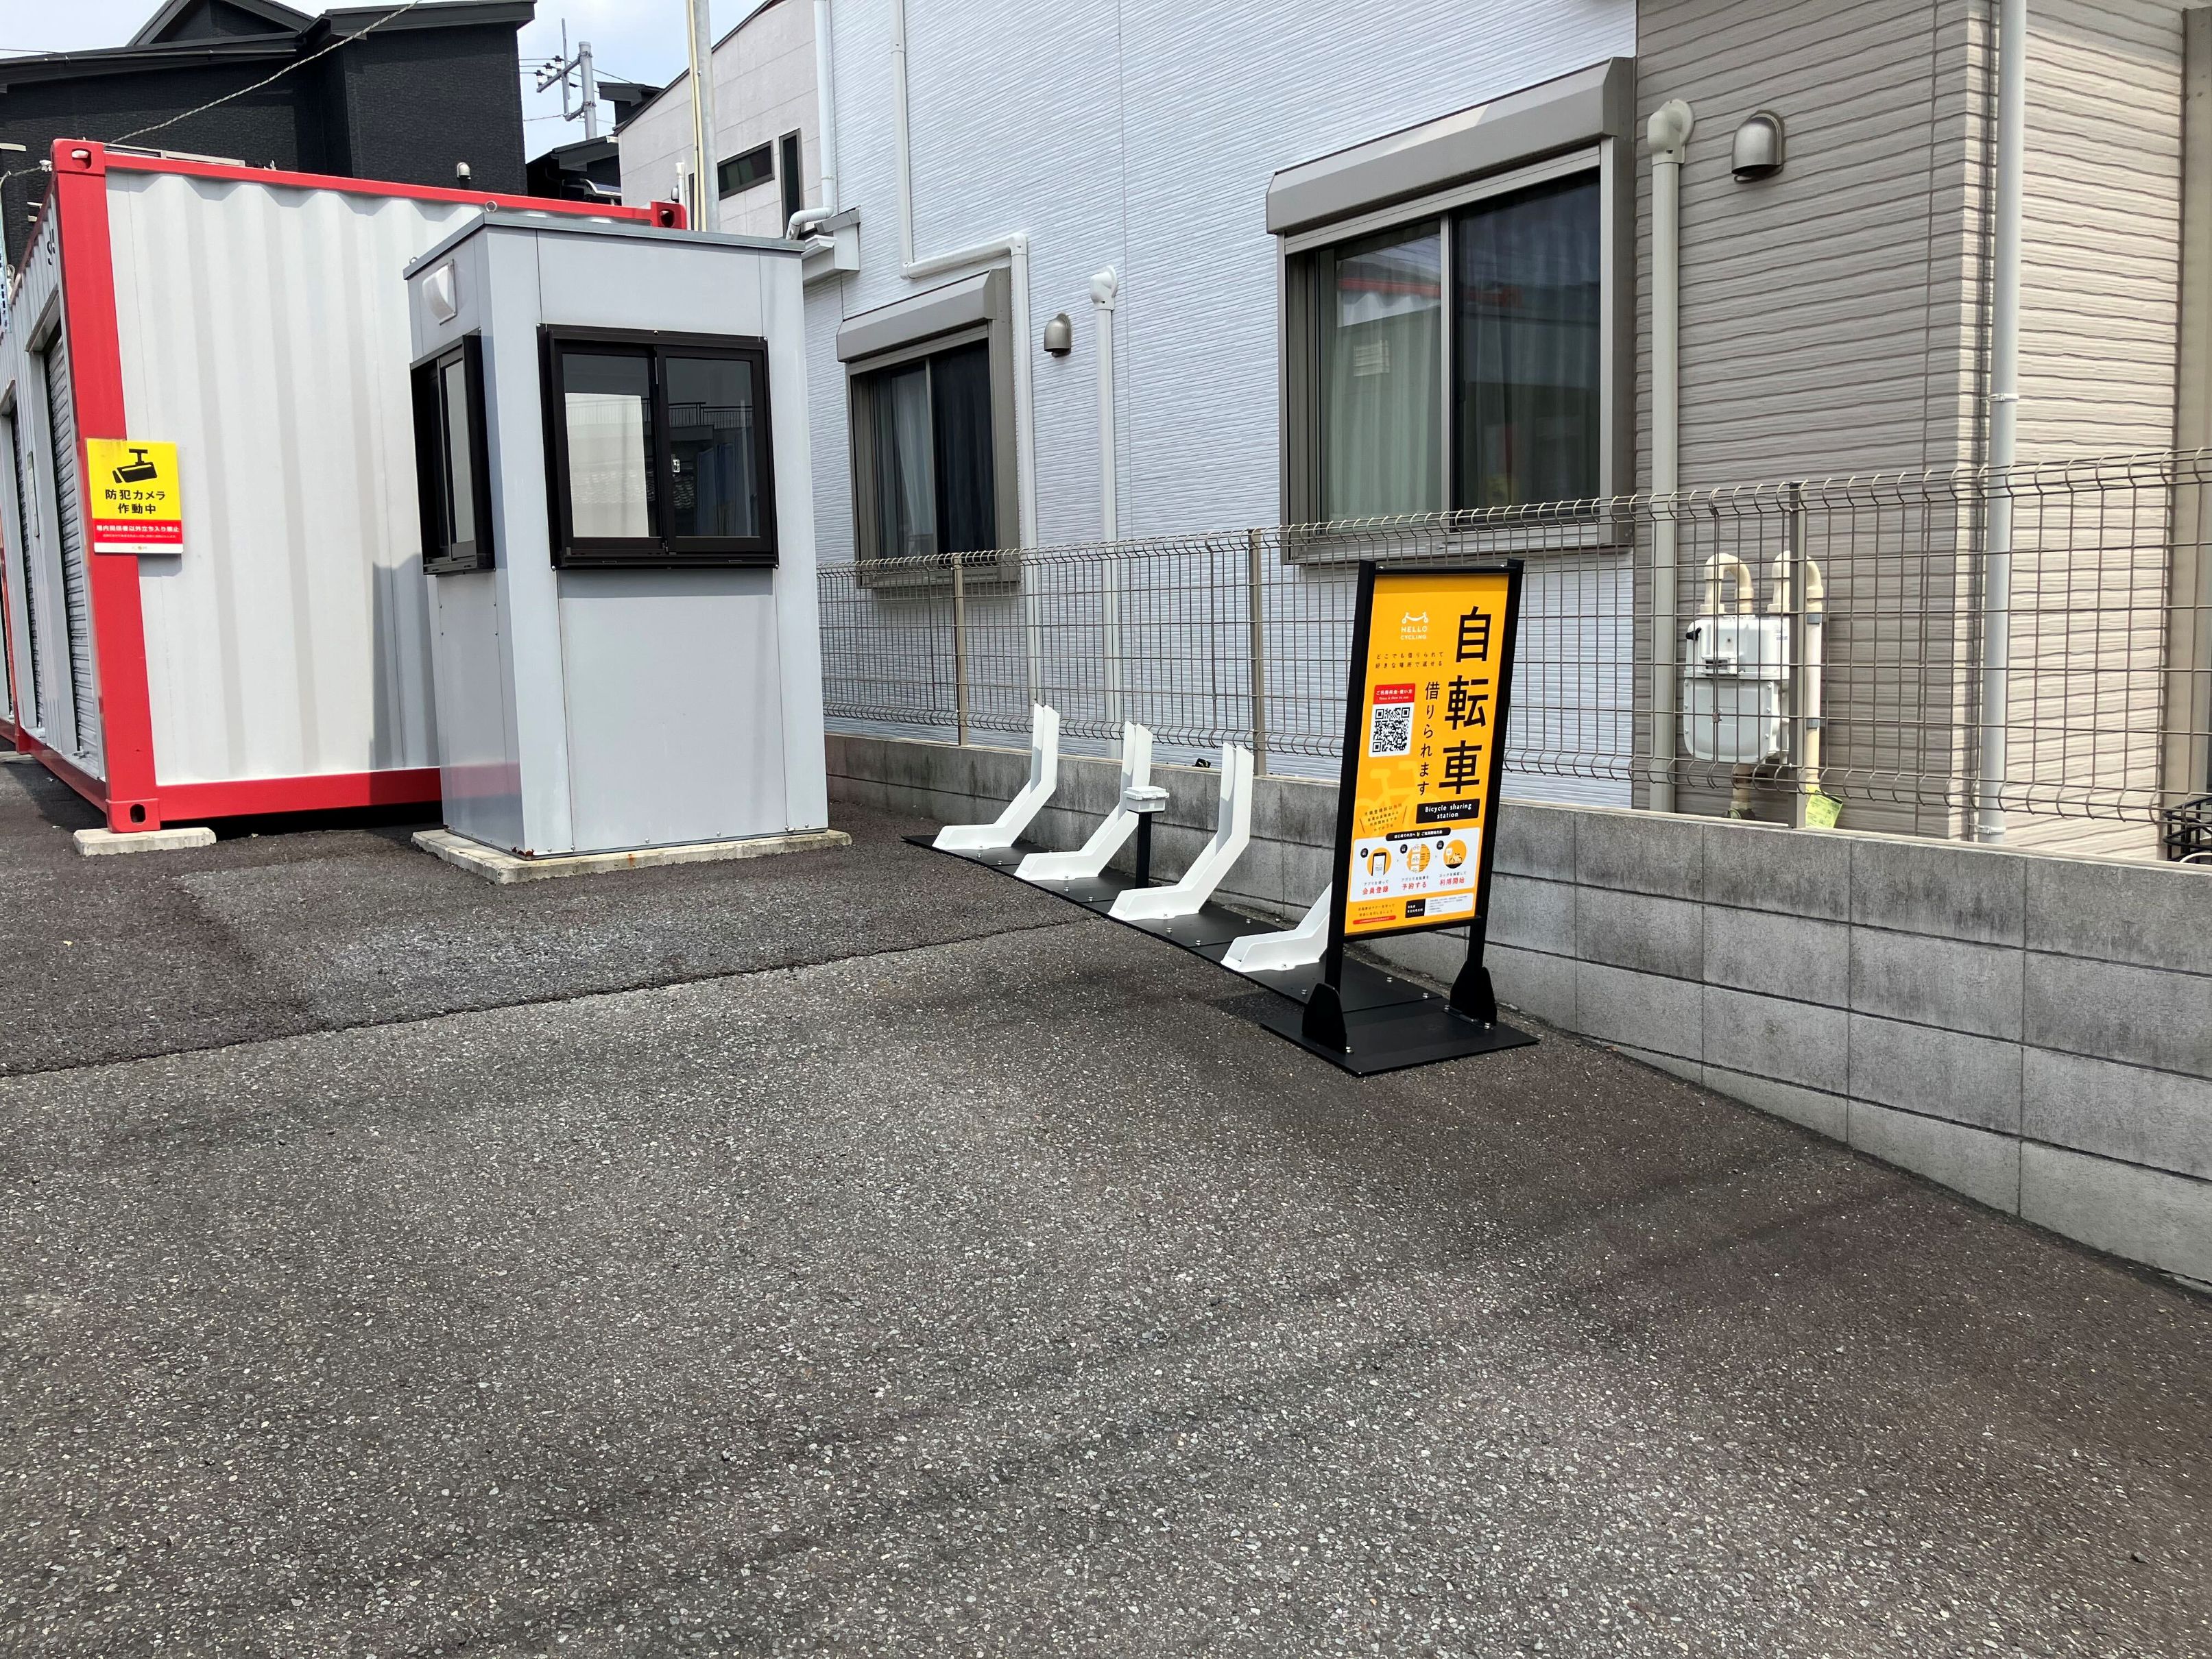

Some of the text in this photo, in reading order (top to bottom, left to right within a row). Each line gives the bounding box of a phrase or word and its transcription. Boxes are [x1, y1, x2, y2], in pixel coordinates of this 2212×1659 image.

[105, 489, 165, 500] 防犯カメラ
[118, 503, 156, 514] 作動中
[1439, 606, 1491, 795] 自転車
[1417, 681, 1440, 796] 借りられます
[1425, 803, 1472, 813] Bicycle sharing
[1402, 882, 1427, 891] 予約する
[1439, 877, 1465, 886] 利用開始
[1362, 886, 1388, 895] 会員登録
